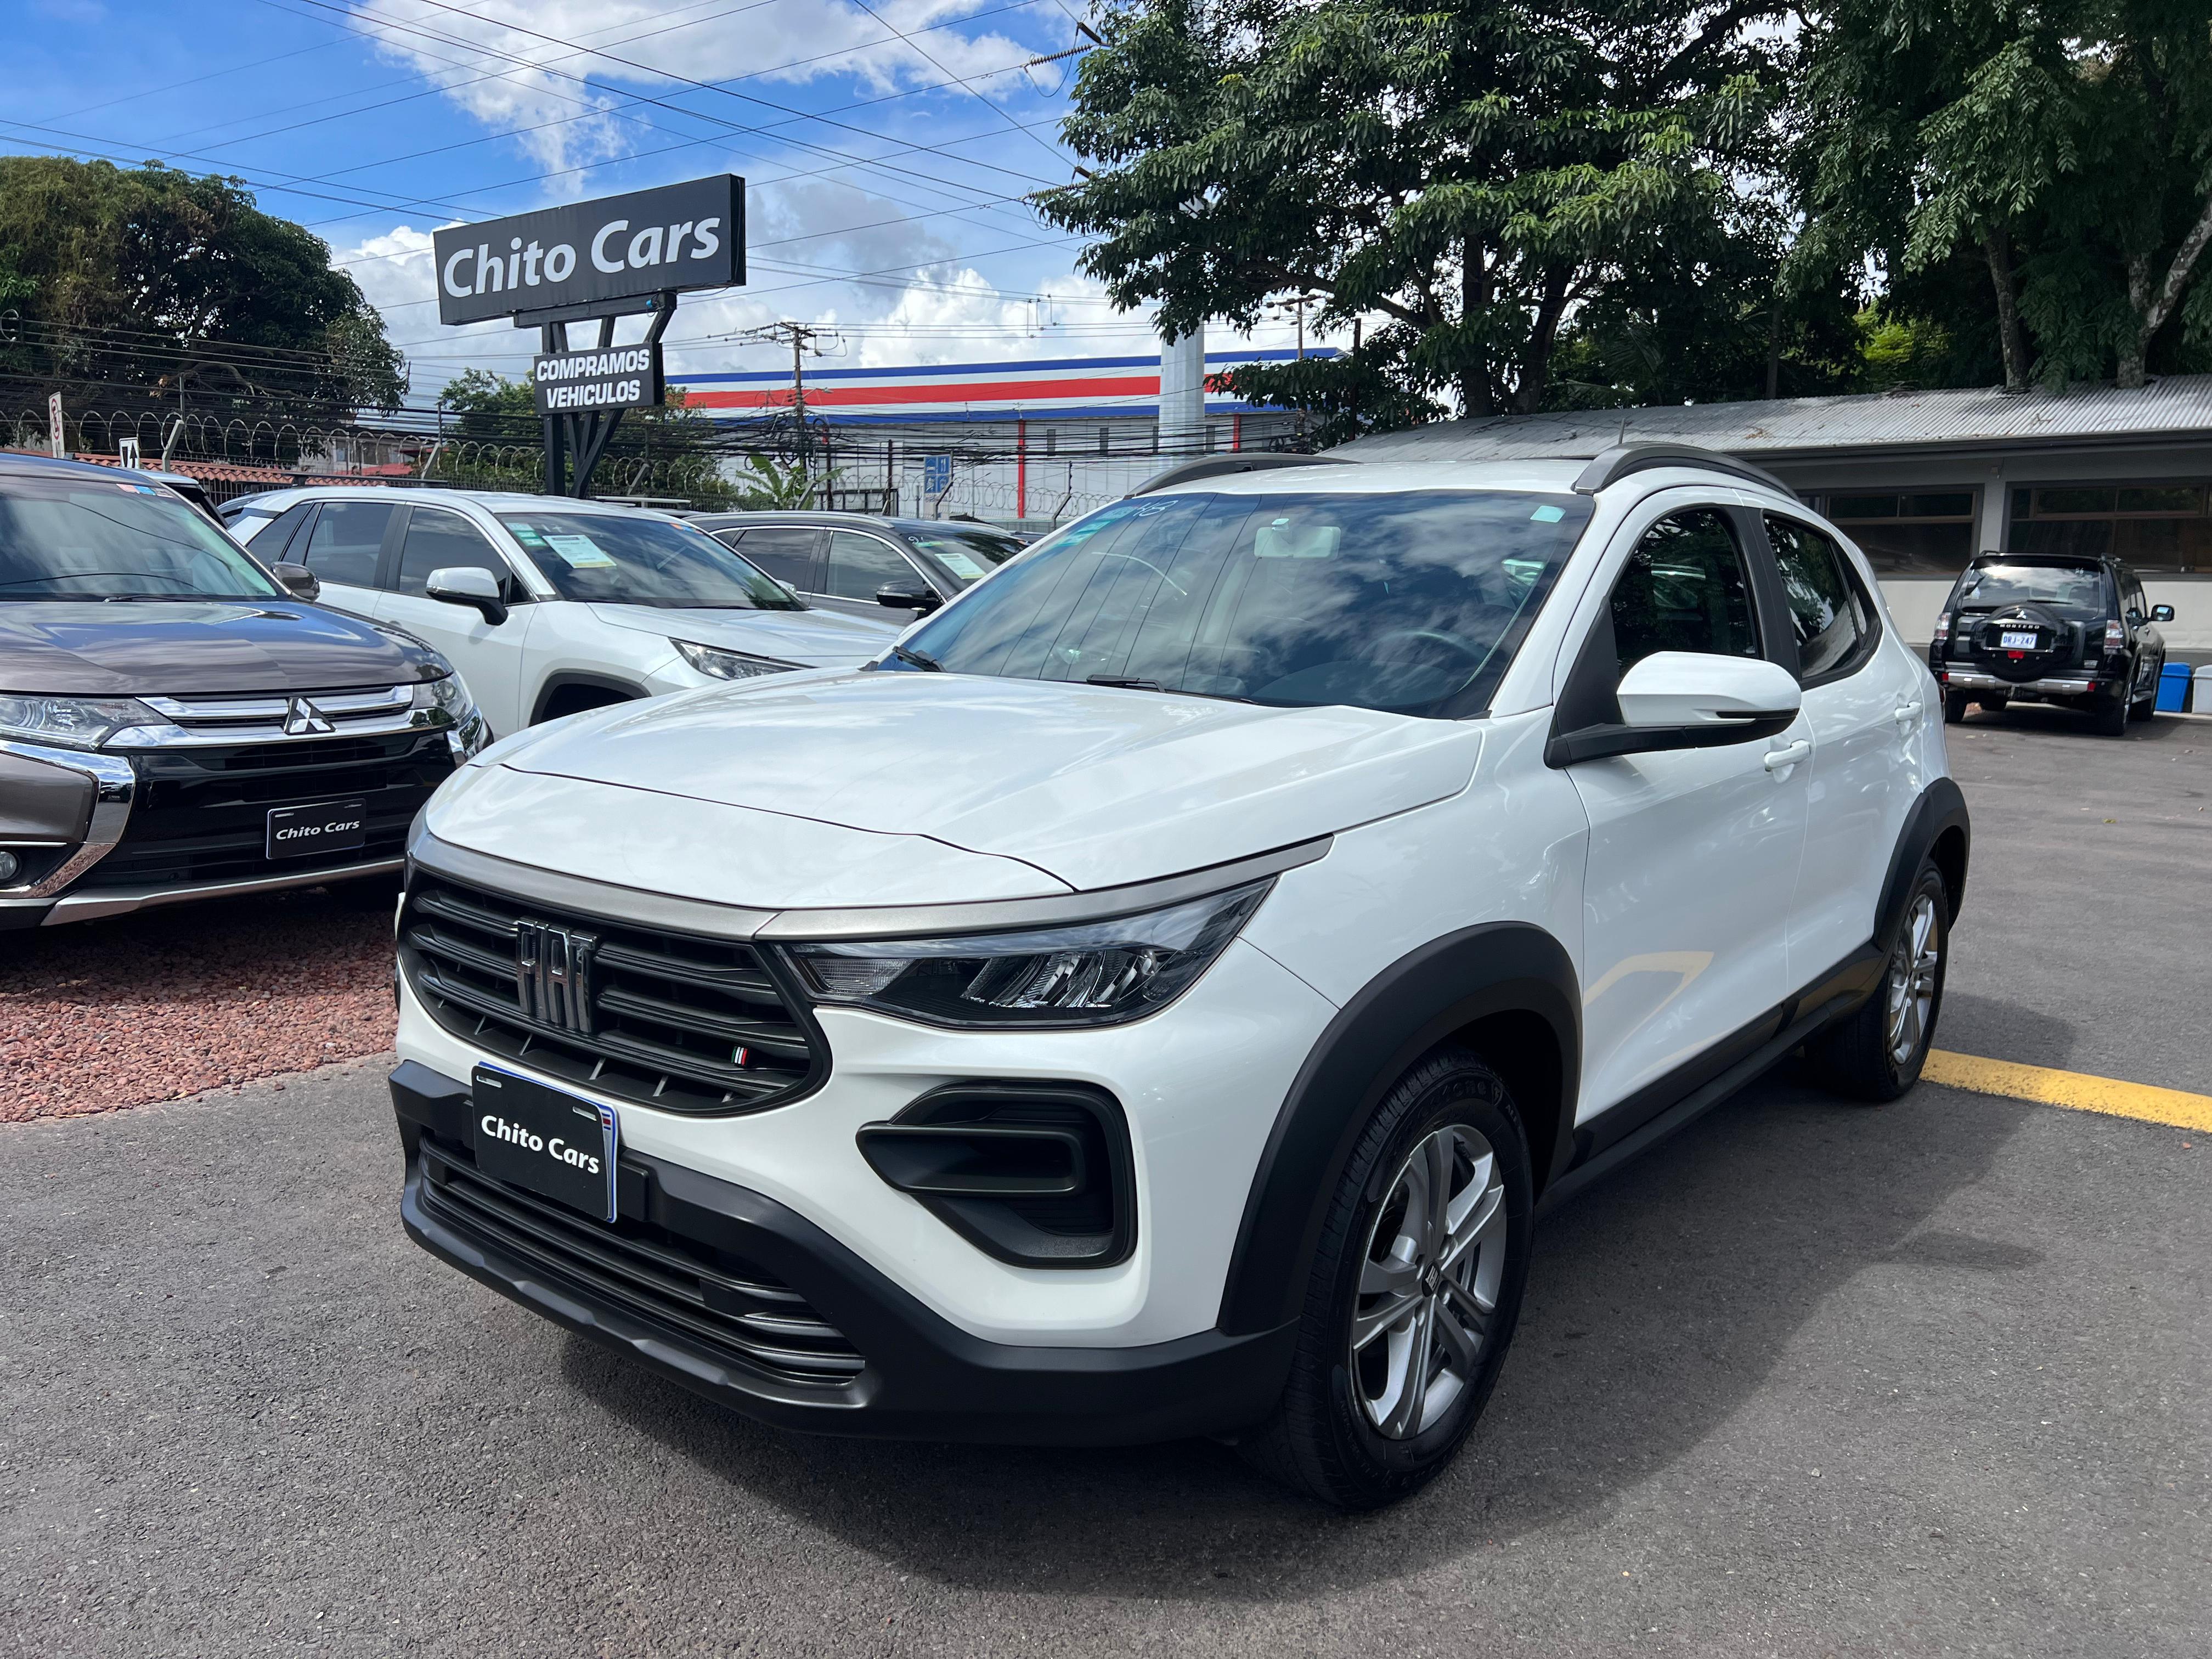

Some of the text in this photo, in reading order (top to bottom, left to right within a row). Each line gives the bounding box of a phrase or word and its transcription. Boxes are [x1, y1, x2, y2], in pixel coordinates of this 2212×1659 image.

[443, 217, 720, 298] Chito Cars
[537, 348, 650, 381] COMPRAMOS
[546, 379, 640, 409] VEHICULOS
[276, 821, 360, 840] Chito Cars
[516, 919, 597, 1034] FIAT
[481, 1115, 600, 1174] Chito Cars
